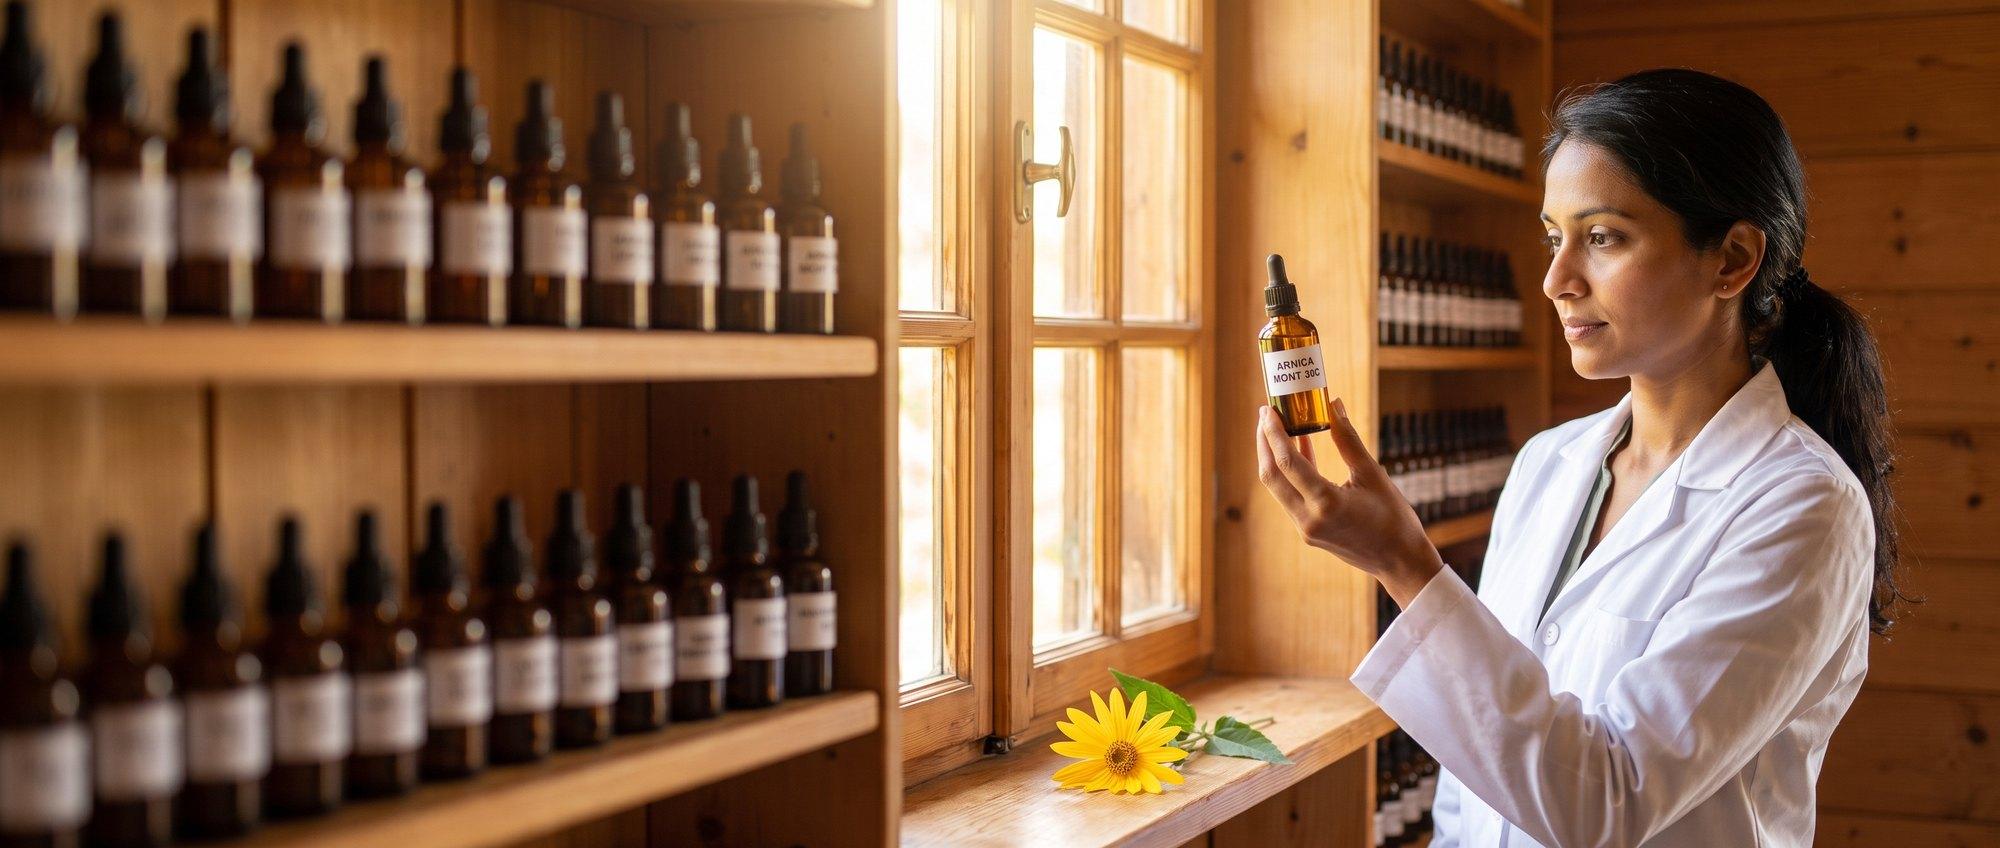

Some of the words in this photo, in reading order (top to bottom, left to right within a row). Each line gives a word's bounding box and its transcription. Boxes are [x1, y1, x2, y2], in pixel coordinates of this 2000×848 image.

[1277, 357, 1315, 371] ARNICA
[1273, 371, 1301, 383] MONT
[1304, 367, 1321, 379] 30C
